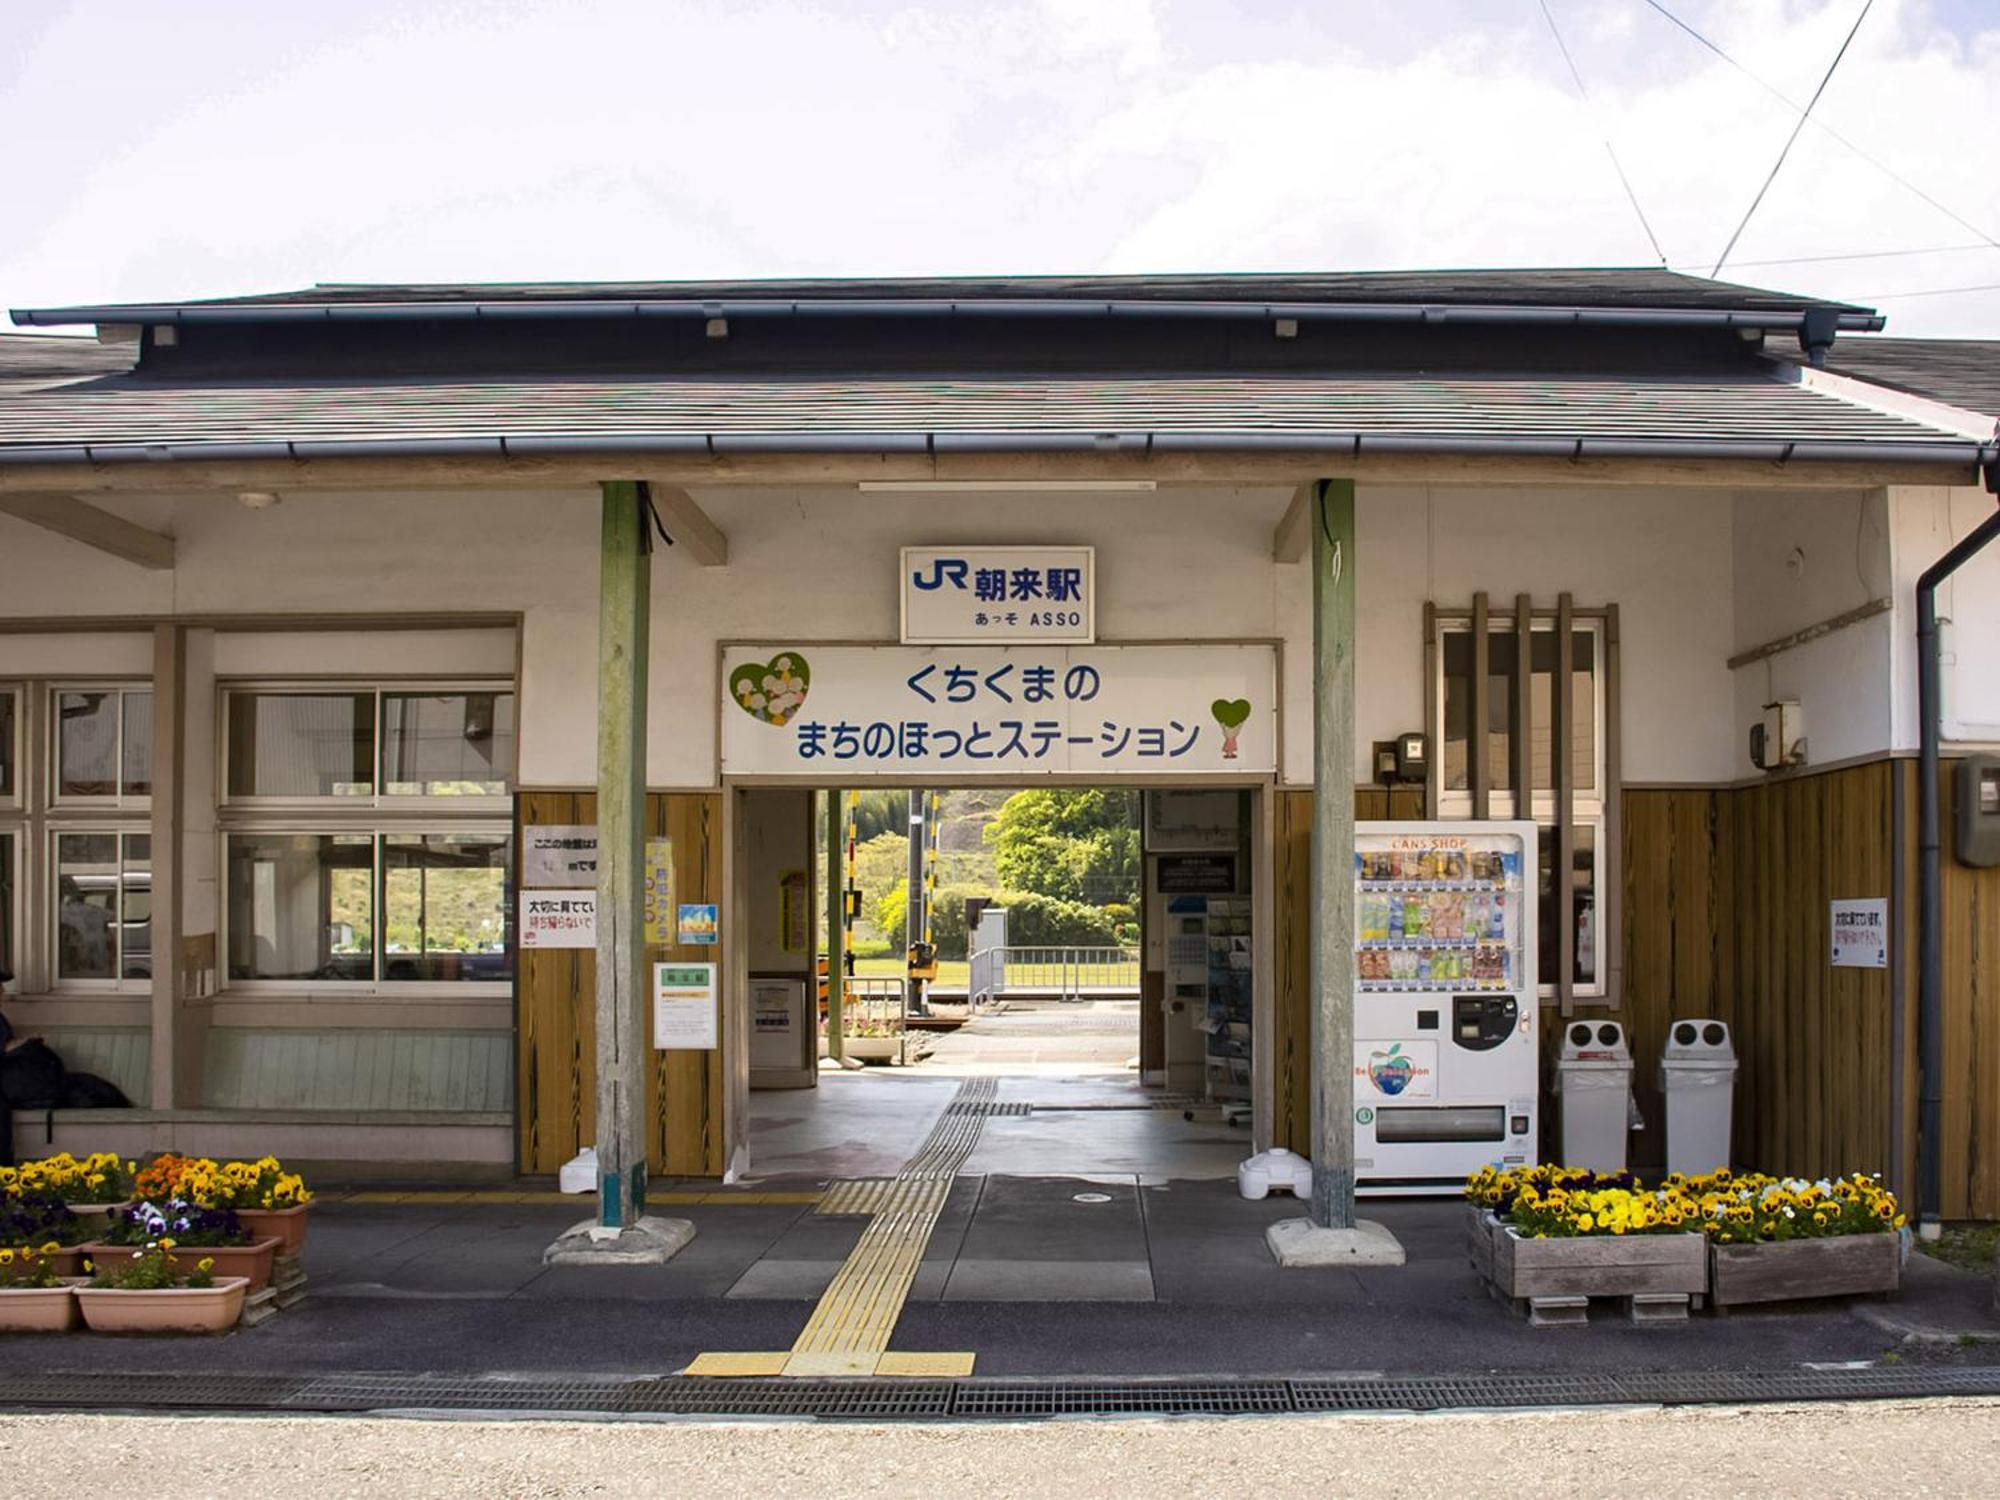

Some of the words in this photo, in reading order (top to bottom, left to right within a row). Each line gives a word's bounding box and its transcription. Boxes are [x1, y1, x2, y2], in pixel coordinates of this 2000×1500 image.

[913, 559, 969, 590] JR
[974, 567, 1082, 602] 朝来駅
[975, 612, 1018, 626] あっそ
[1029, 611, 1080, 626] ASSO
[907, 663, 1100, 703] くちくまの
[797, 720, 1200, 760] まちのほっとステーション
[1431, 838, 1466, 849] SHOP
